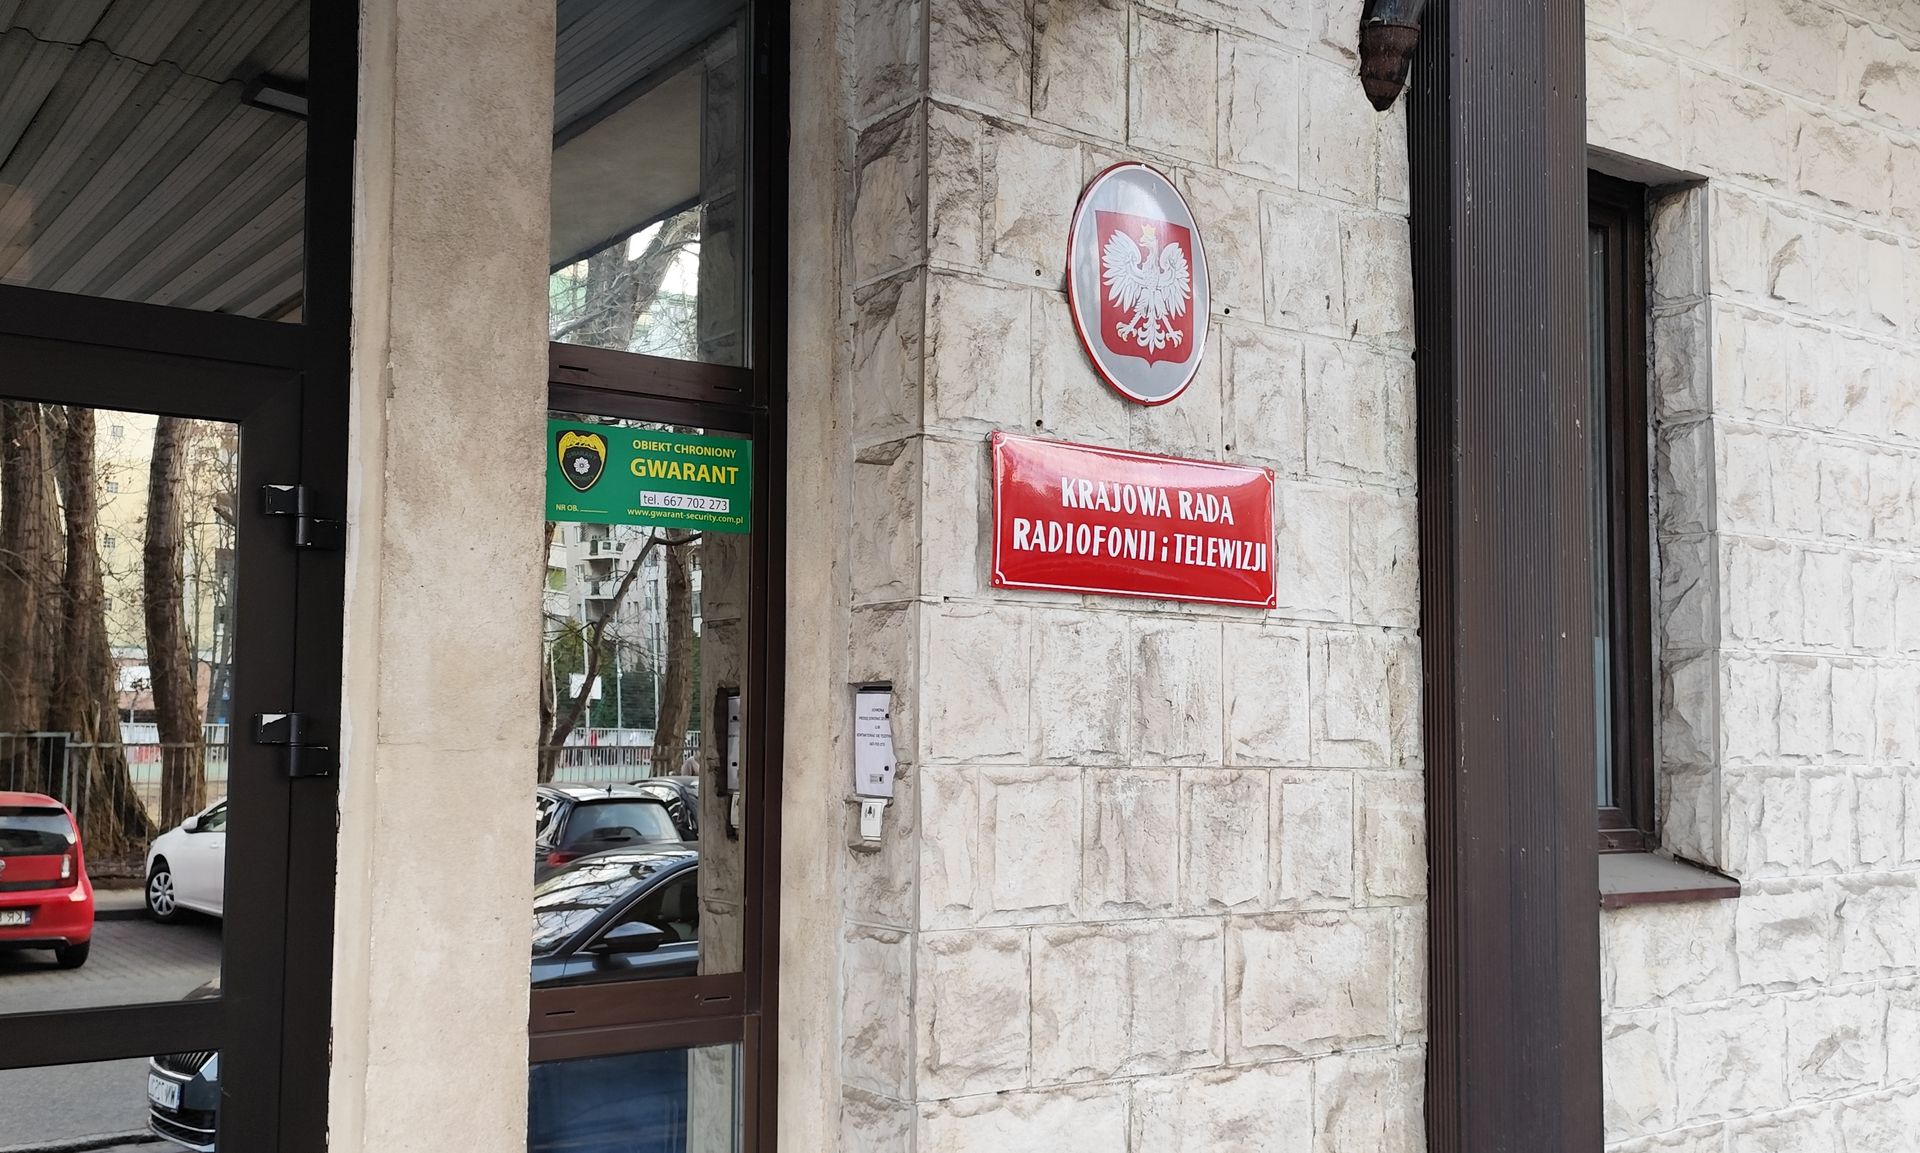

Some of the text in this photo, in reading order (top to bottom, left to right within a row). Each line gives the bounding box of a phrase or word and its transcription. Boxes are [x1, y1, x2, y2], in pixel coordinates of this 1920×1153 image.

[632, 440, 737, 459] OBIEKT CHRONIONY
[630, 457, 739, 485] GWARANT
[555, 503, 579, 512] NR OB.
[643, 493, 728, 511] tel. 667 702 273
[1061, 476, 1235, 526] KRAJOWA RADA
[627, 507, 744, 525] www.gwarant-security.com.pl
[1012, 517, 1268, 573] RADIOFONII i TELEWIZJI
